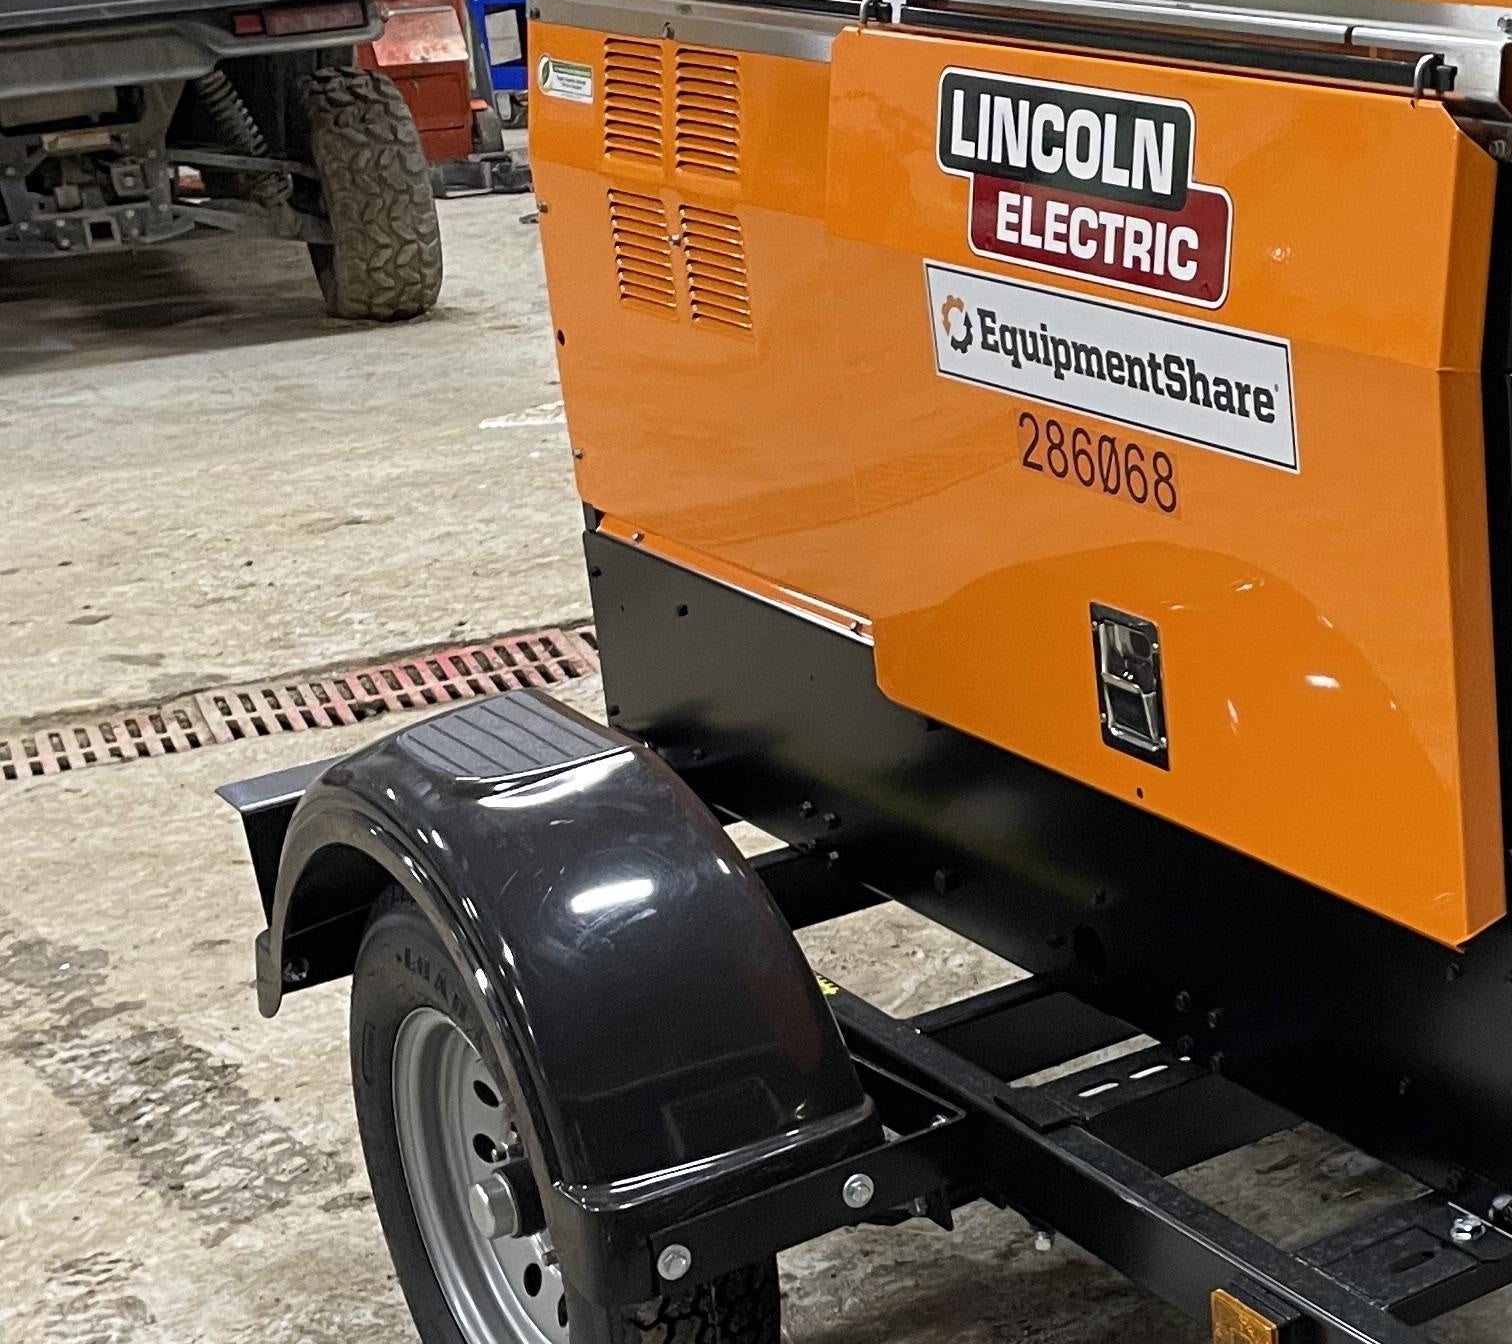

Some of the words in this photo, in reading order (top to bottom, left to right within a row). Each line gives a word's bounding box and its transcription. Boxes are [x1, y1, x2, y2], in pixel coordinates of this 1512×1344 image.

[950, 88, 1175, 195] LINCOLN
[996, 190, 1199, 282] ELECTRIC
[977, 308, 1275, 424] EquipmentShare
[1018, 411, 1177, 512] 286068
